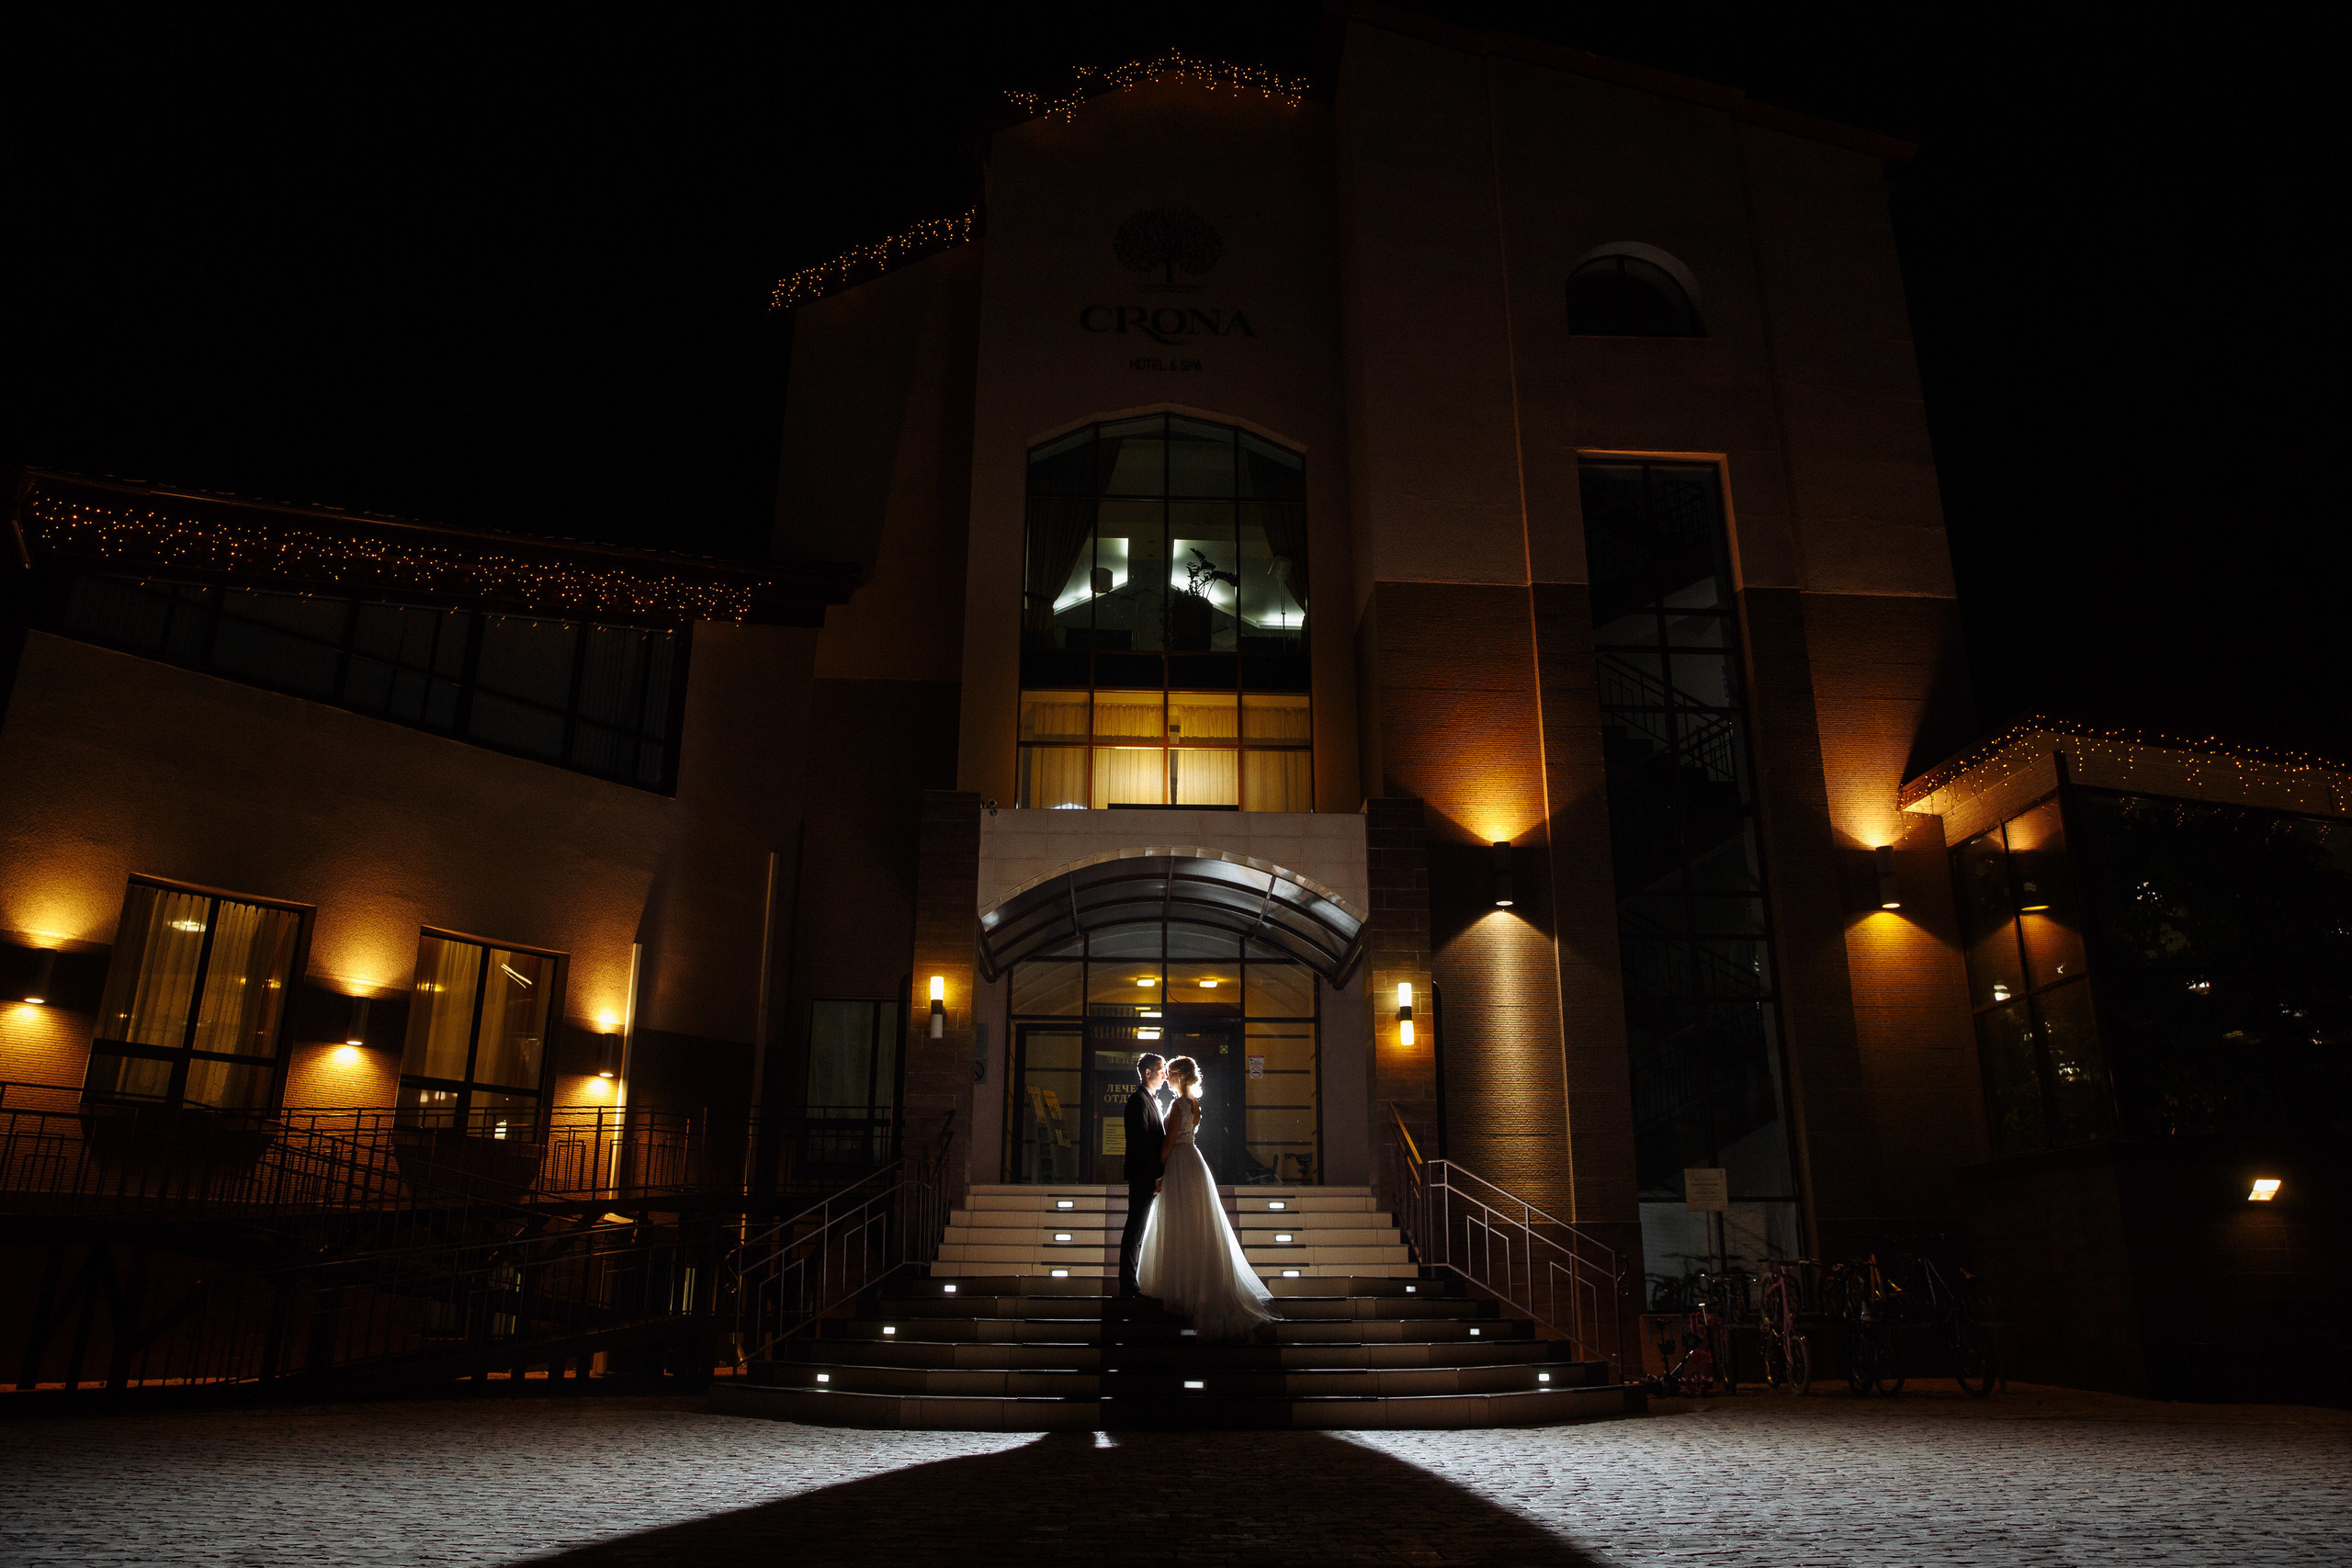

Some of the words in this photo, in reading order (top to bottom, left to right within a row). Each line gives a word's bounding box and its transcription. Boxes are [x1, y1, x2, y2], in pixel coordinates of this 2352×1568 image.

[1080, 304, 1257, 345] CRONA
[1129, 358, 1167, 372] HOTEL
[1169, 359, 1178, 372] &
[1181, 359, 1203, 372] SPA
